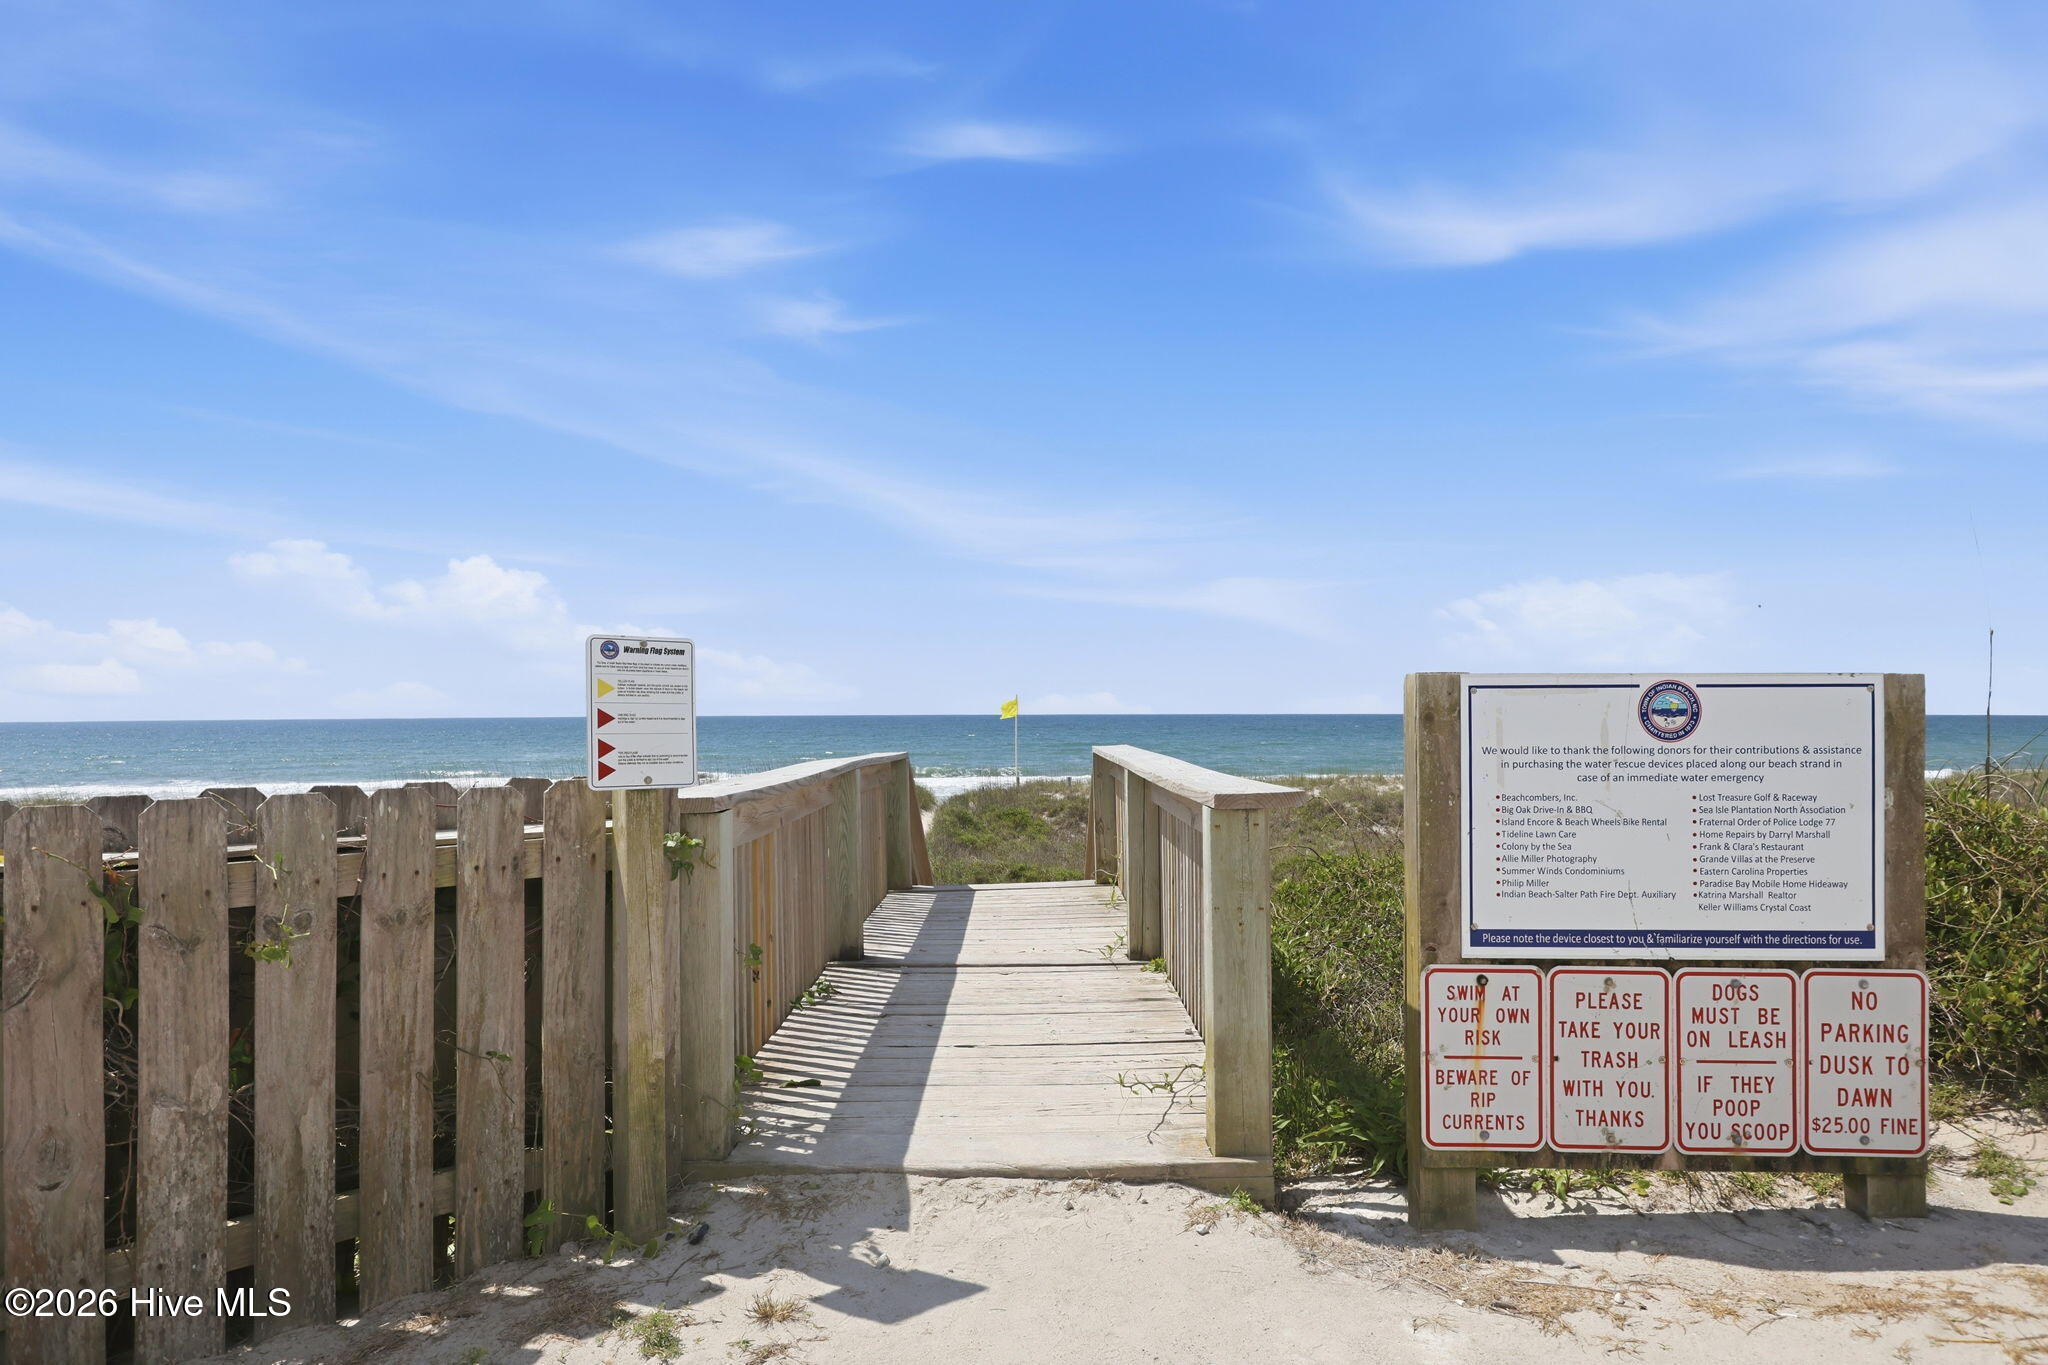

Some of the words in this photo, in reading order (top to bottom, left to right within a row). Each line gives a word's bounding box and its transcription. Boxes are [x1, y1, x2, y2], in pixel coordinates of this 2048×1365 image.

[623, 645, 649, 655] Warning
[649, 647, 663, 655] Flag
[663, 647, 685, 656] System
[1500, 746, 1529, 755] would
[1532, 746, 1548, 755] like
[1563, 746, 1590, 755] thank
[1592, 746, 1609, 755] the
[1611, 745, 1655, 757] following
[1657, 745, 1691, 755] donors
[1693, 745, 1707, 755] for
[1709, 745, 1733, 755] their
[1735, 745, 1800, 755] contributions
[1802, 745, 1810, 754] &
[1813, 746, 1862, 754] assistance
[1501, 760, 1509, 768] in
[1512, 759, 1564, 771] purchasing
[1566, 759, 1582, 768] the
[1584, 760, 1612, 769] water
[1614, 759, 1646, 768] rescue
[1648, 759, 1683, 768] devices
[1686, 759, 1717, 770] placed
[1720, 759, 1747, 770] along
[1768, 759, 1797, 768] beach
[1800, 759, 1830, 768] strand
[1833, 759, 1842, 768] in
[1600, 773, 1610, 782] of
[1627, 773, 1678, 782] immediate
[1711, 775, 1764, 784] emergency
[1501, 793, 1561, 803] Beachcombers,
[1754, 793, 1771, 802] Golf
[1773, 793, 1780, 802] &
[1782, 793, 1817, 803] Raceway
[1501, 806, 1514, 815] Big
[1515, 805, 1531, 814] Oak
[1566, 805, 1573, 814] &
[1575, 805, 1593, 814] BBQ
[1699, 806, 1713, 814] Sea
[1715, 806, 1729, 814] Isle
[1731, 805, 1772, 814] Plantation
[1774, 806, 1798, 814] North
[1799, 806, 1846, 814] Association
[1699, 818, 1735, 826] Fraternal
[1737, 818, 1761, 826] Order
[1762, 818, 1772, 826] of
[1773, 818, 1797, 826] Police
[1799, 818, 1823, 827] Lodge
[1558, 830, 1577, 839] Care
[1501, 842, 1529, 852] Colony
[1531, 842, 1541, 852] by
[1542, 842, 1556, 851] the
[1557, 842, 1572, 851] Sea
[1732, 842, 1759, 851] Clara's
[1761, 843, 1804, 851] Restaurant
[1501, 854, 1519, 863] Allie
[1521, 854, 1544, 863] Miller
[1546, 854, 1597, 864] Photography
[1699, 855, 1729, 863] Grande
[1731, 855, 1753, 863] Villas
[1765, 855, 1778, 863] the
[1780, 855, 1815, 863] Preserve
[1501, 867, 1535, 875] Summer
[1565, 867, 1625, 875] Condominiums
[1731, 867, 1765, 876] Carolina
[1766, 867, 1808, 877] Properties
[1735, 880, 1750, 889] Bay
[1752, 880, 1780, 888] Mobile
[1809, 880, 1848, 889] Hideaway
[1698, 891, 1727, 900] Katrina
[1768, 891, 1797, 899] Realtor
[1760, 903, 1787, 913] Crystal
[1789, 903, 1811, 912] Coast
[1482, 933, 1511, 943] Please
[1513, 934, 1534, 943] note
[1535, 934, 1550, 944] the
[1552, 934, 1581, 944] device
[1583, 934, 1613, 944] closest
[1615, 934, 1626, 944] to
[1627, 936, 1645, 946] you
[1646, 934, 1654, 943] &
[1656, 934, 1702, 946] familiarize
[1704, 934, 1741, 946] yourself
[1743, 934, 1762, 945] with
[1765, 934, 1779, 945] the
[1782, 934, 1827, 945] directions
[1828, 934, 1842, 945] for
[1844, 936, 1862, 945] use.
[1447, 984, 1487, 1002] SWIM
[1502, 986, 1520, 1001] AT
[1712, 983, 1759, 1001] DOGS
[1576, 991, 1643, 1010] PLEASE
[1852, 991, 1877, 1011] NO
[1438, 1006, 1484, 1024] YOUR
[1496, 1008, 1529, 1024] OWN
[1692, 1007, 1740, 1025] MUST
[1758, 1008, 1780, 1025] BE
[1465, 1029, 1501, 1046] RISK
[1558, 1021, 1600, 1039] TAKE
[1613, 1022, 1660, 1040] YOUR
[1821, 1023, 1908, 1043] PARKING
[1687, 1030, 1710, 1048] ON
[1729, 1031, 1786, 1049] LEASH
[1581, 1051, 1638, 1068] TRASH
[1820, 1055, 1873, 1075] DUSK
[1885, 1054, 1910, 1076] TO
[1436, 1069, 1498, 1085] BEWARE
[1511, 1070, 1531, 1086] OF
[1698, 1076, 1713, 1093] IF
[1730, 1076, 1775, 1094] THEY
[1563, 1080, 1603, 1097] WITH
[1616, 1081, 1654, 1098] YOU.
[1471, 1092, 1496, 1108] RIP
[1838, 1088, 1892, 1108] DAWN
[1713, 1099, 1760, 1117] POOP
[1443, 1114, 1525, 1132] CURRENTS
[1575, 1109, 1644, 1128] THANKS
[1812, 1117, 1870, 1134] $25.00
[1881, 1118, 1918, 1135] FINE
[1685, 1122, 1721, 1140] YOU
[1727, 1123, 1789, 1142] SCOOP
